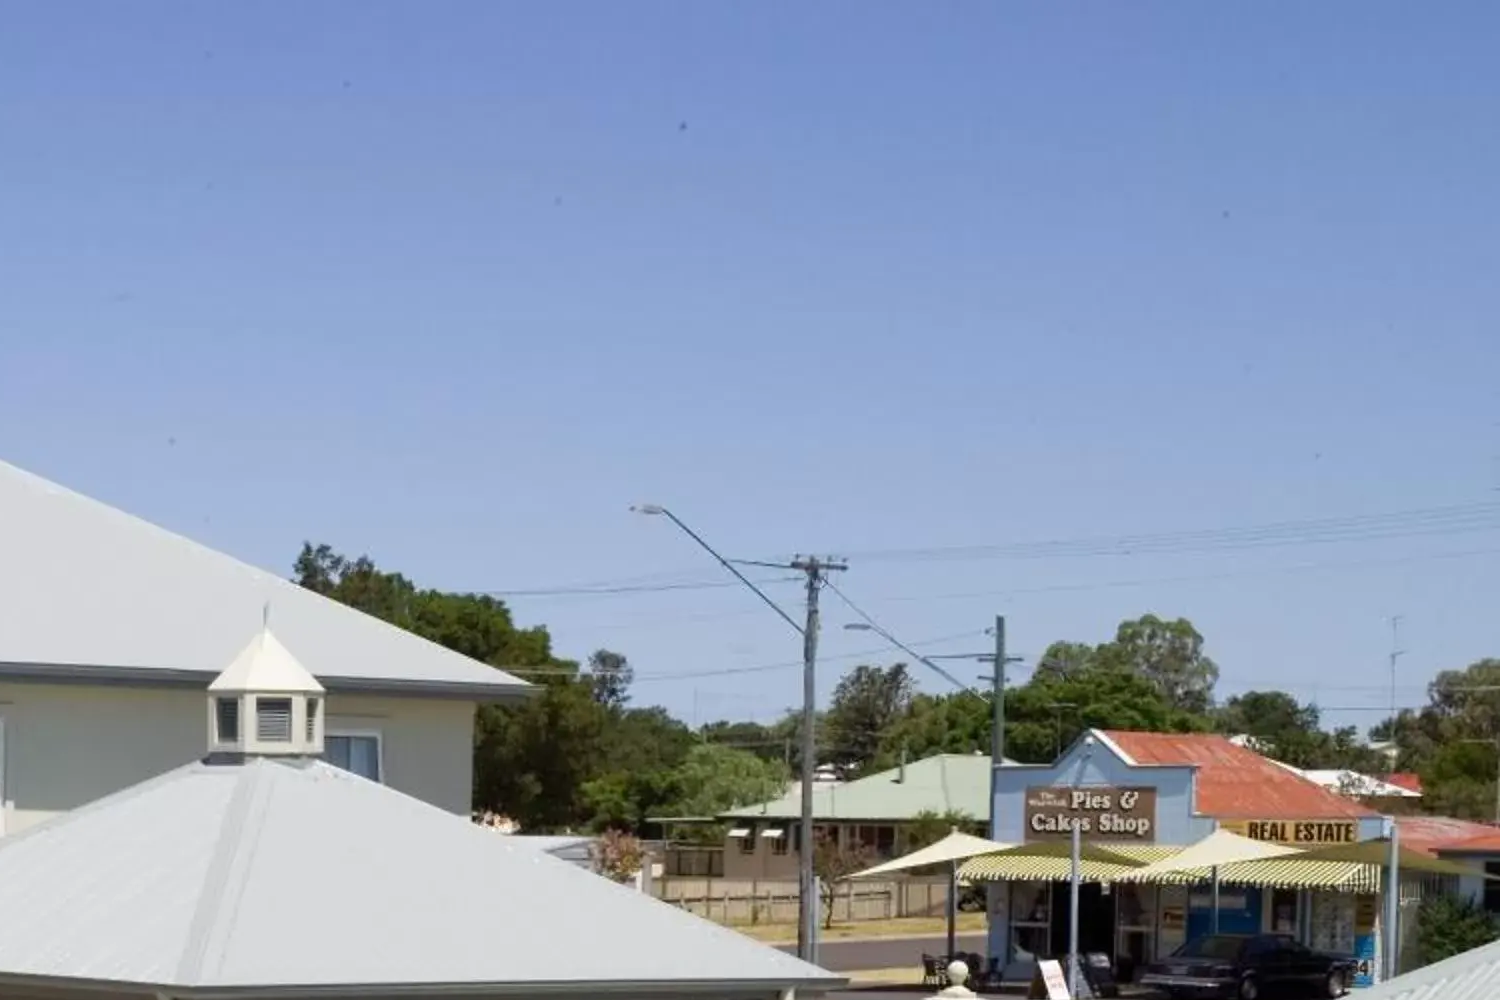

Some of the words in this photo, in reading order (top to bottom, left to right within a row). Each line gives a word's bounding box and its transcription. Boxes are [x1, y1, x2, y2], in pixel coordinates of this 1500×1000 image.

[1070, 791, 1111, 809] Pies
[1120, 791, 1139, 809] &
[1031, 813, 1091, 831] Cakes
[1099, 813, 1150, 836] Shop
[1247, 821, 1288, 841] REAL
[1295, 822, 1353, 842] ESTATE
